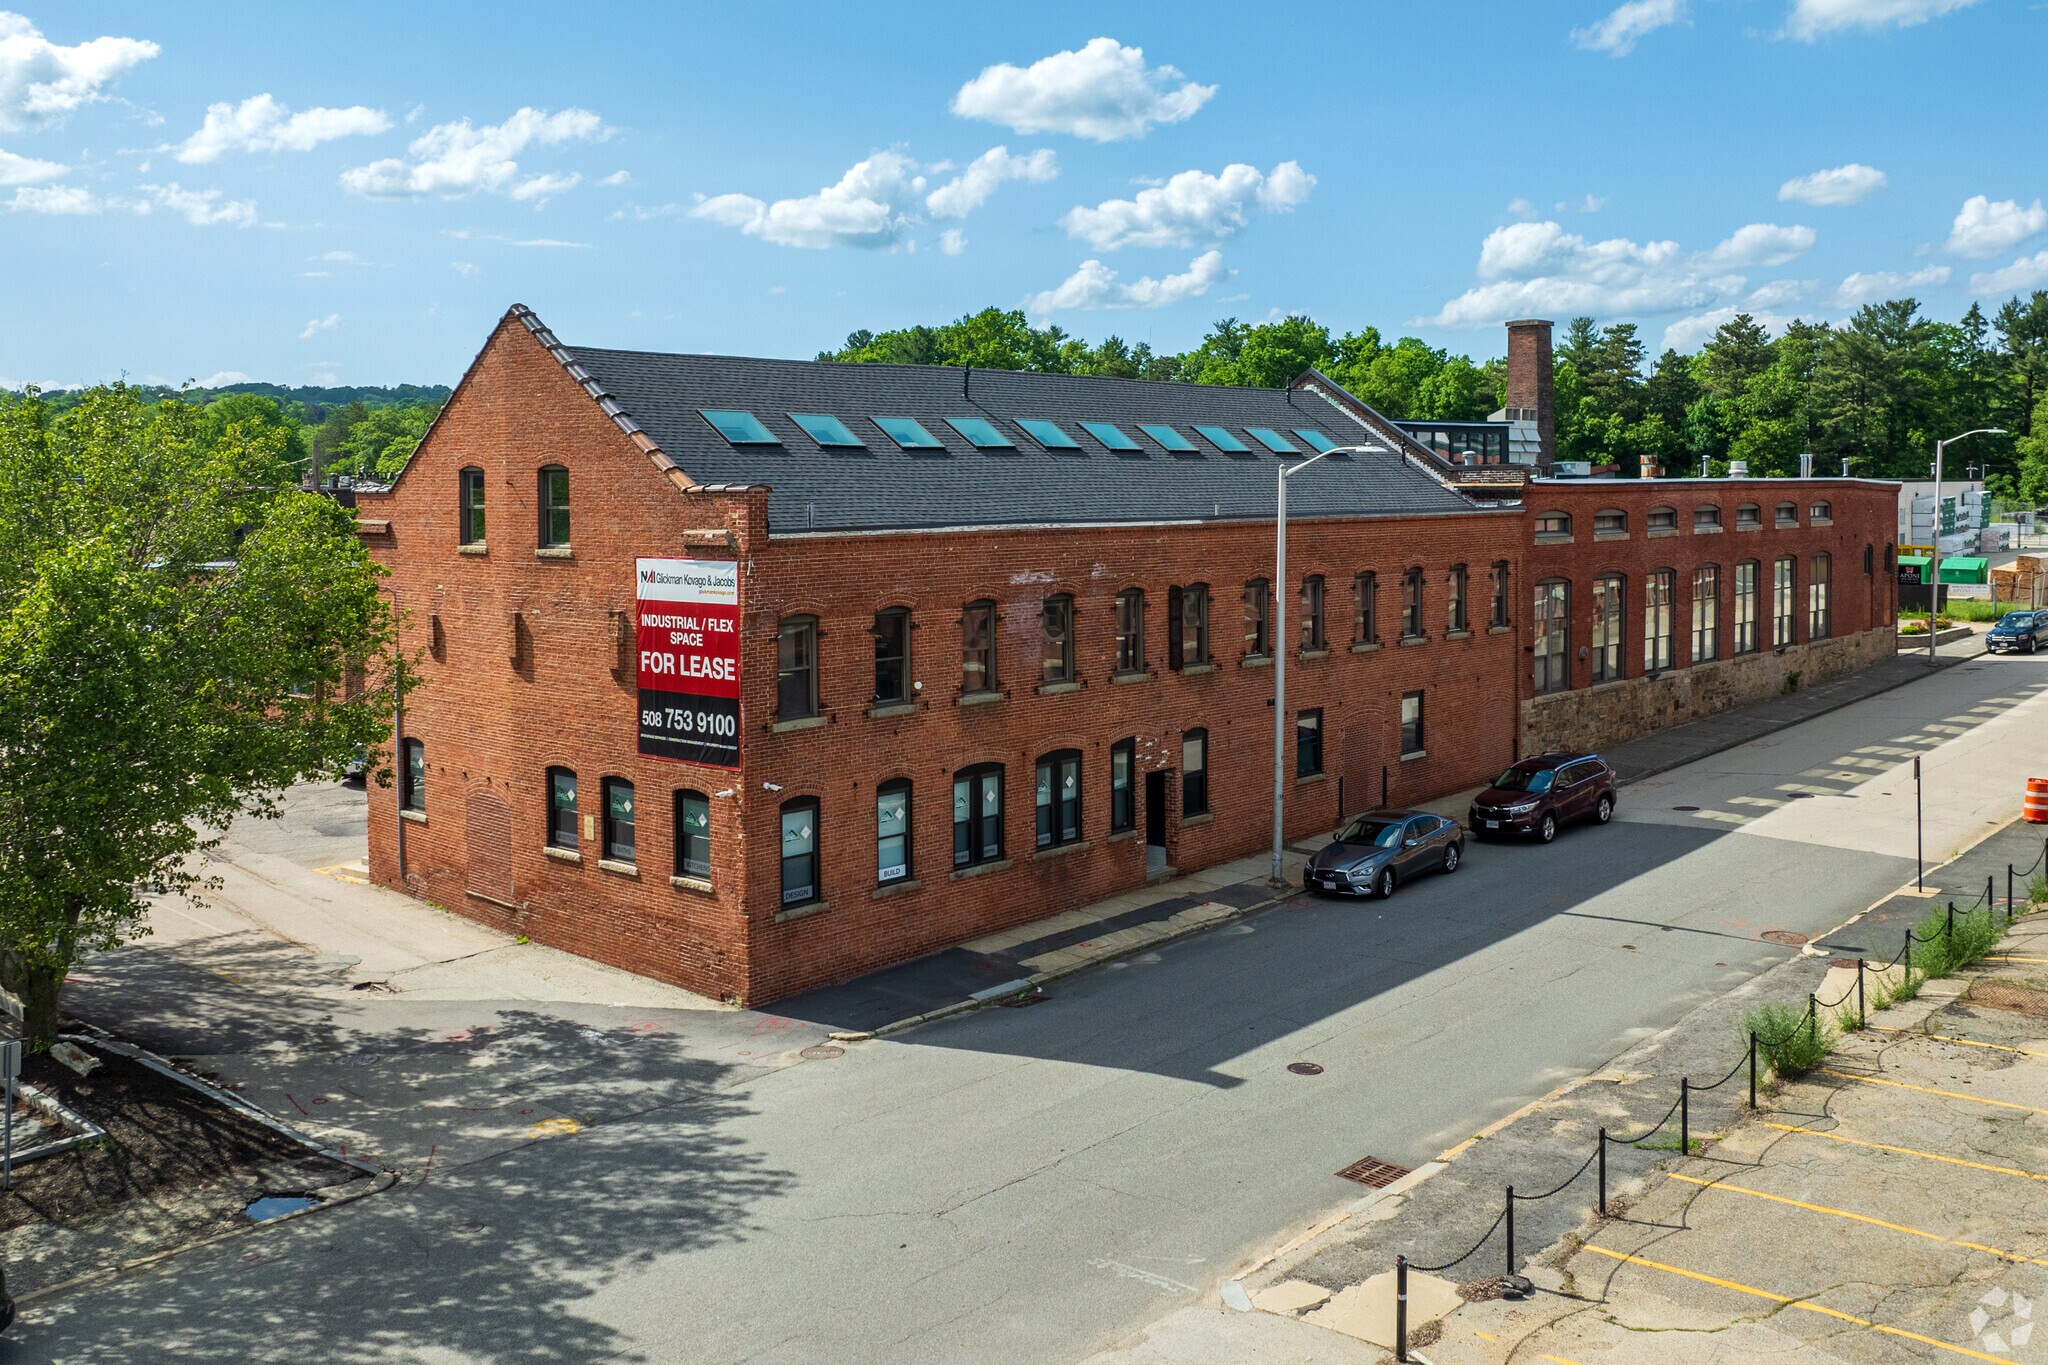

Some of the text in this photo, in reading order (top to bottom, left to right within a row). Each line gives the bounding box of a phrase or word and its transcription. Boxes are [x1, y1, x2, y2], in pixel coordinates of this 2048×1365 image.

[640, 568, 736, 588] NAI Glickman Kovago & Jacobs
[641, 613, 734, 633] INDUSTRIAL / FLEX
[670, 631, 704, 647] SPACE
[641, 650, 736, 681] FOR LEASE
[642, 707, 736, 737] 508 753 9100
[883, 867, 901, 878] BUILD
[785, 889, 809, 900] DESIGN
